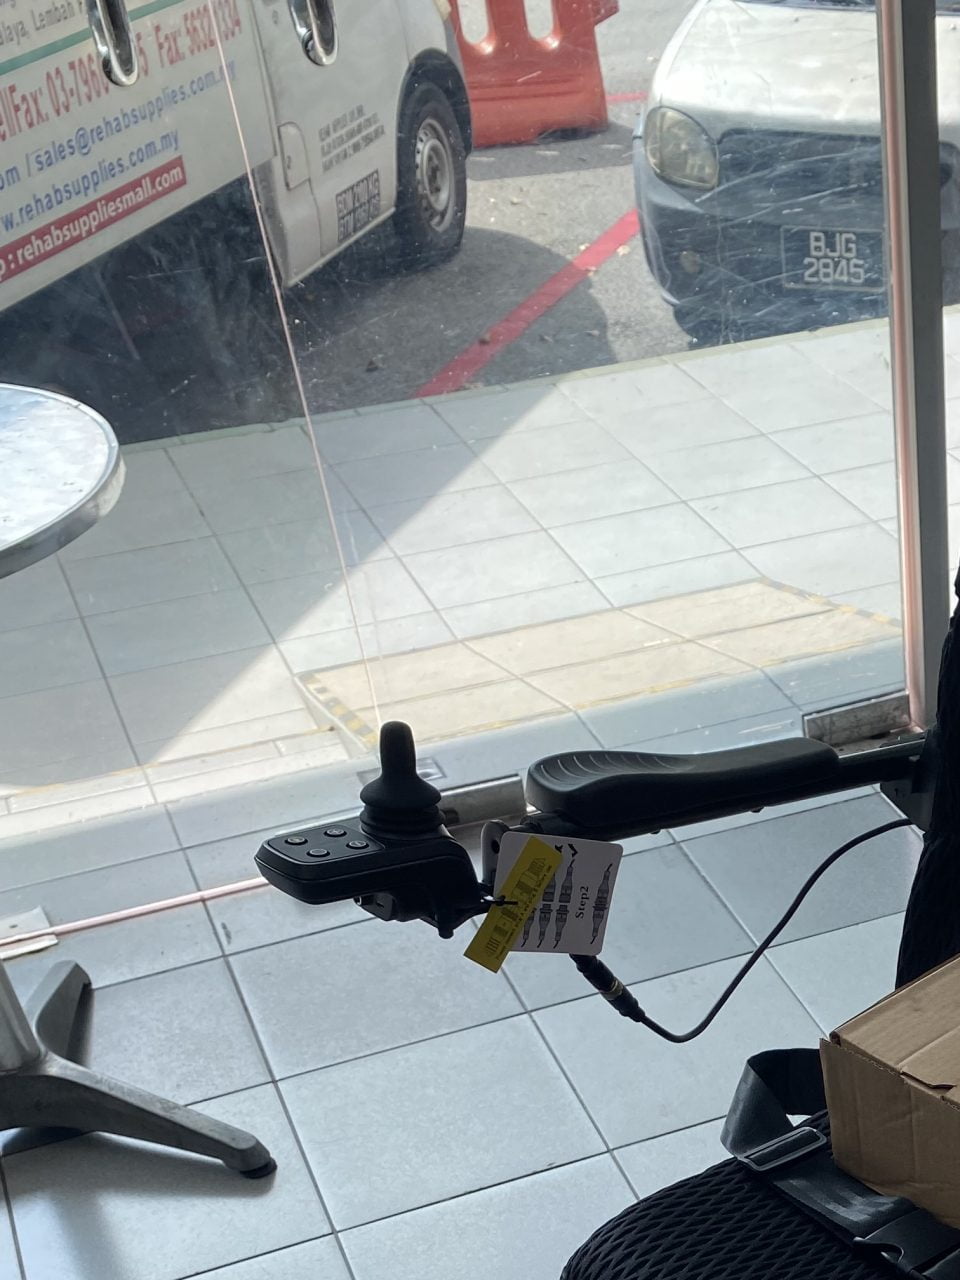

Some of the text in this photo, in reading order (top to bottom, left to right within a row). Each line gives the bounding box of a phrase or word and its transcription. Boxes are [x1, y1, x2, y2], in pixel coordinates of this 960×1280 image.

[16, 166, 184, 265] rehabsuppliesmall.com
[809, 231, 857, 257] BJG
[803, 257, 866, 284] 2845
[574, 885, 590, 920] Step2
